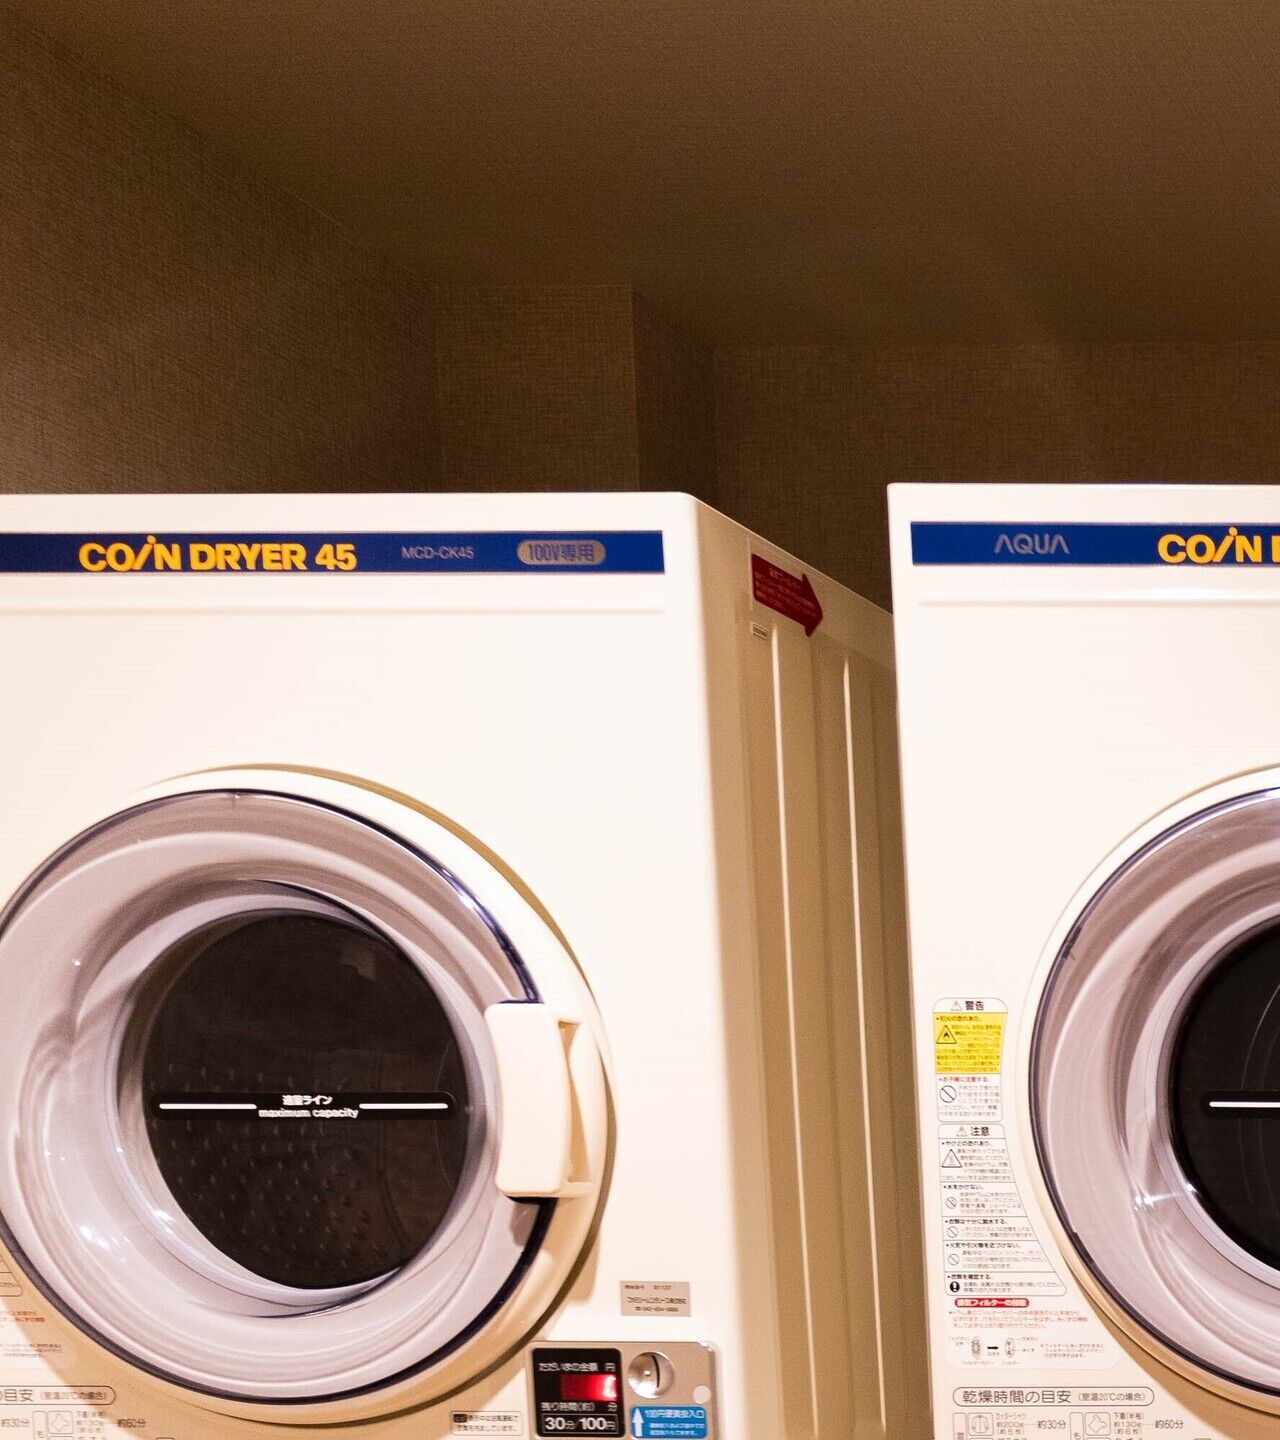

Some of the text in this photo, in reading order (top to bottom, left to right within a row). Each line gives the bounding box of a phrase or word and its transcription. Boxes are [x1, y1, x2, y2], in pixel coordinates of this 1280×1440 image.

[994, 534, 1069, 554] AQUA
[190, 544, 306, 570] DRYER
[315, 543, 356, 570] 45
[402, 547, 474, 559] MCD-CK45
[259, 1108, 359, 1119] maximum capacity
[963, 1391, 1071, 1403] 乾燥時間の目安
